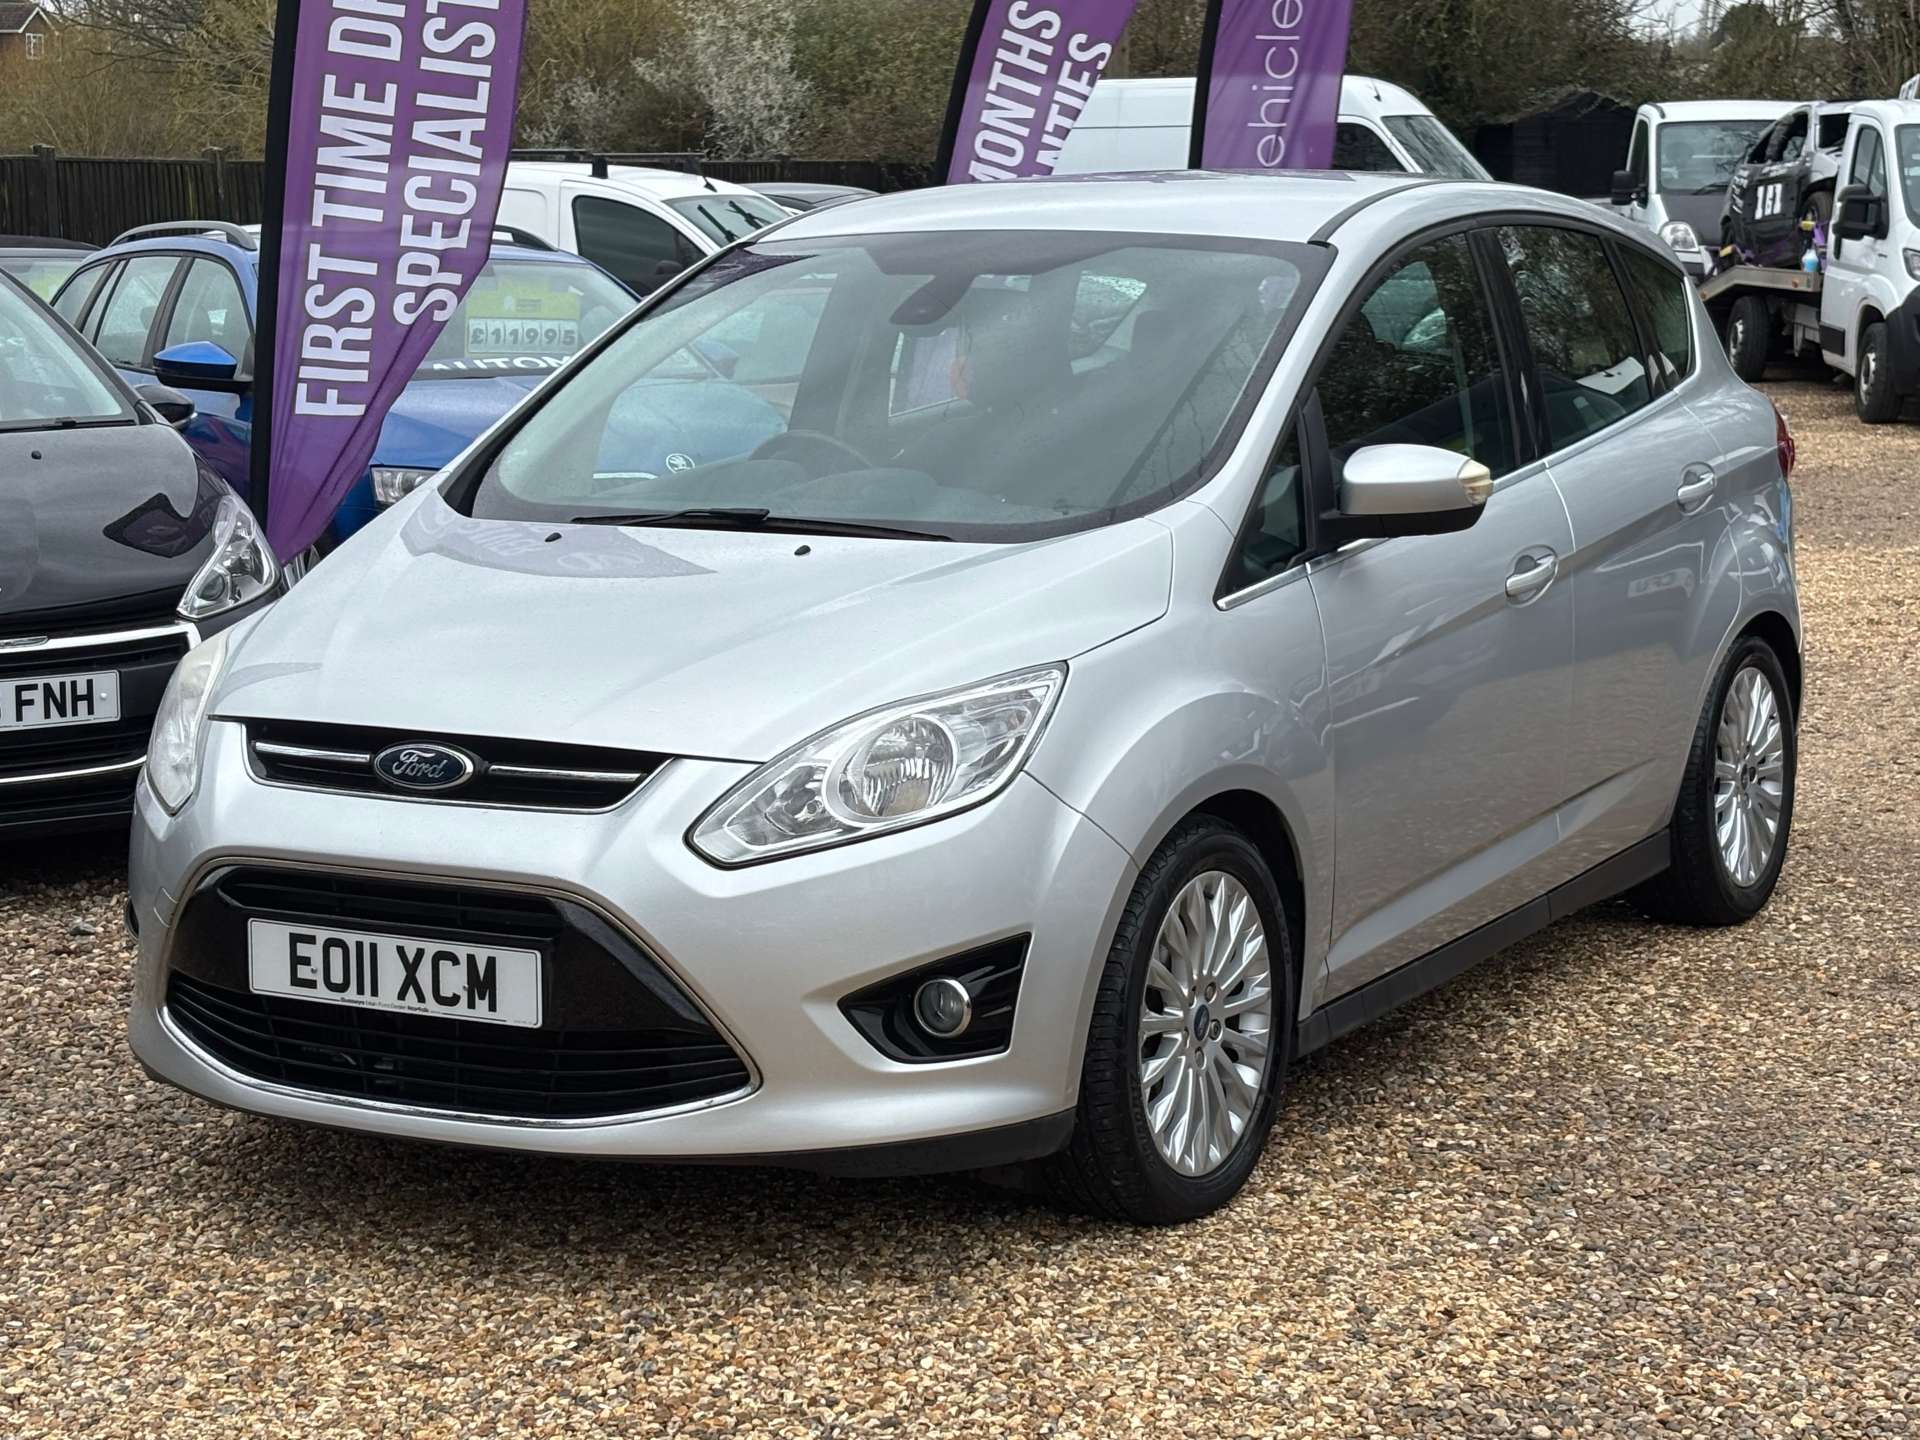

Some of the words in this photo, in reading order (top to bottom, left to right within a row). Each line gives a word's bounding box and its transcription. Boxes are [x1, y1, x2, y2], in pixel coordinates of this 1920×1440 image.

[1032, 33, 1113, 177] NTIES
[312, 74, 398, 227] TIME
[295, 243, 379, 416] FIRST
[470, 326, 577, 346] £11995
[14, 678, 95, 723] FNH
[391, 749, 448, 778] Ford
[288, 931, 379, 998] EO11
[396, 944, 498, 1013] XCM
